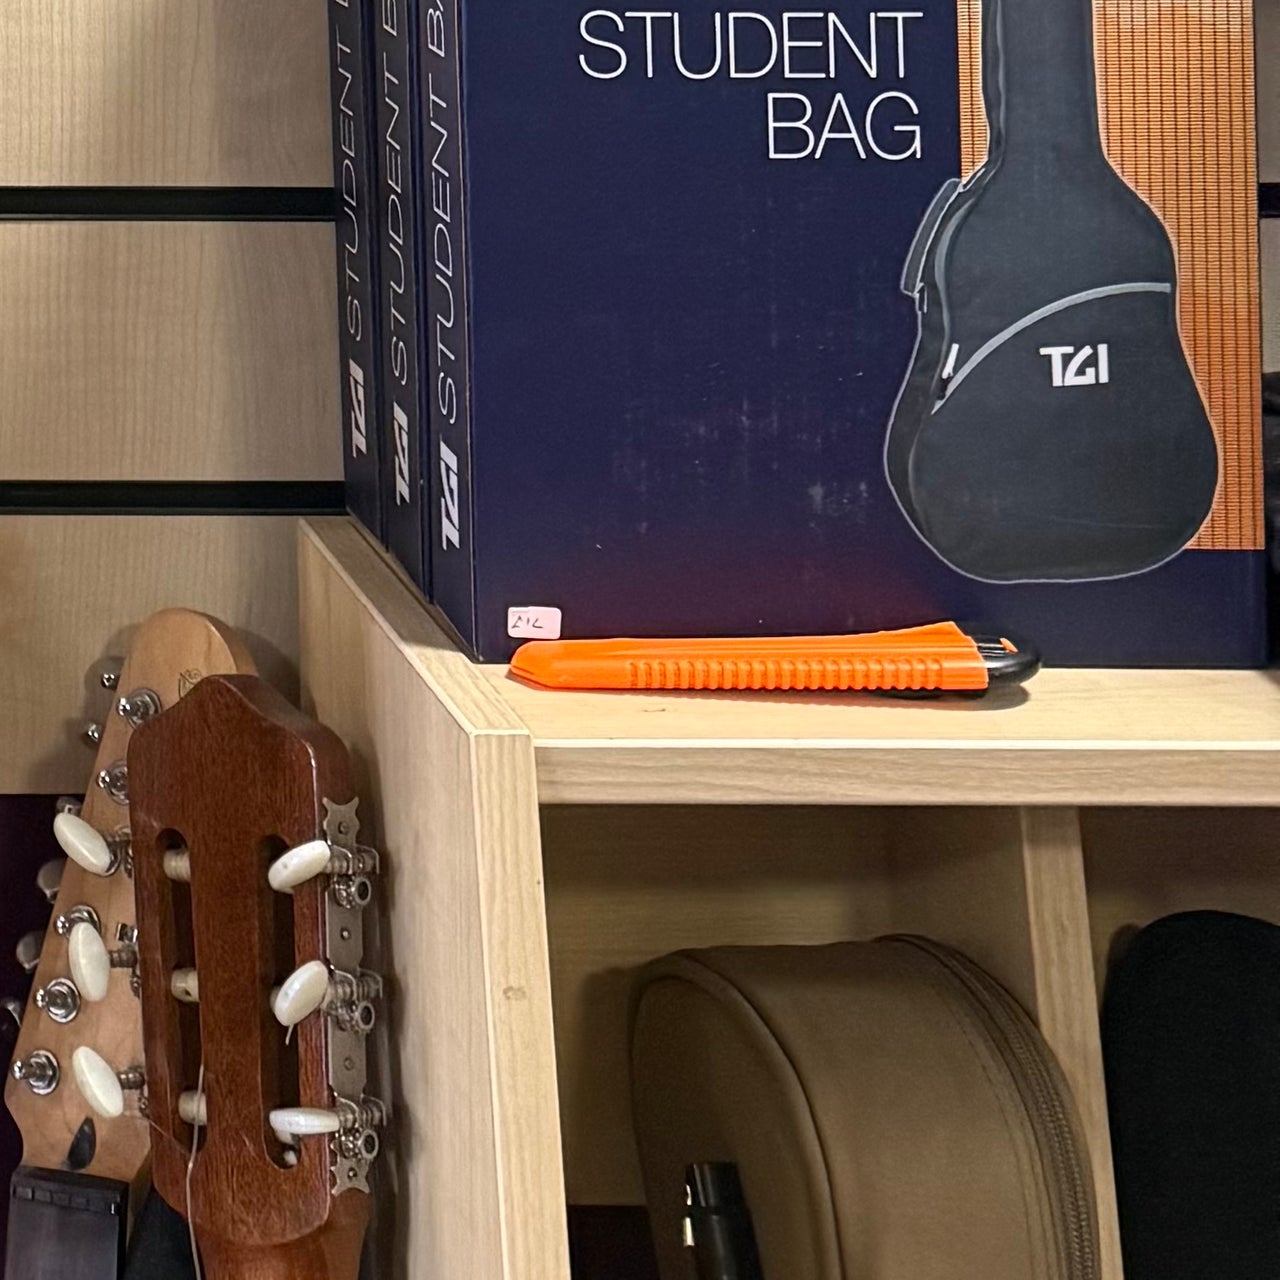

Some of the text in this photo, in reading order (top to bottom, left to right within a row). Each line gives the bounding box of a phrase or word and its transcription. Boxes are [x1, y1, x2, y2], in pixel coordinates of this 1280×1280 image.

[578, 9, 924, 79] STUDENT
[767, 91, 921, 160] BAG
[336, 24, 362, 341] STUDENT
[384, 52, 408, 386] STUDENT
[429, 72, 457, 425] STUDENT
[1039, 343, 1109, 387] TGI
